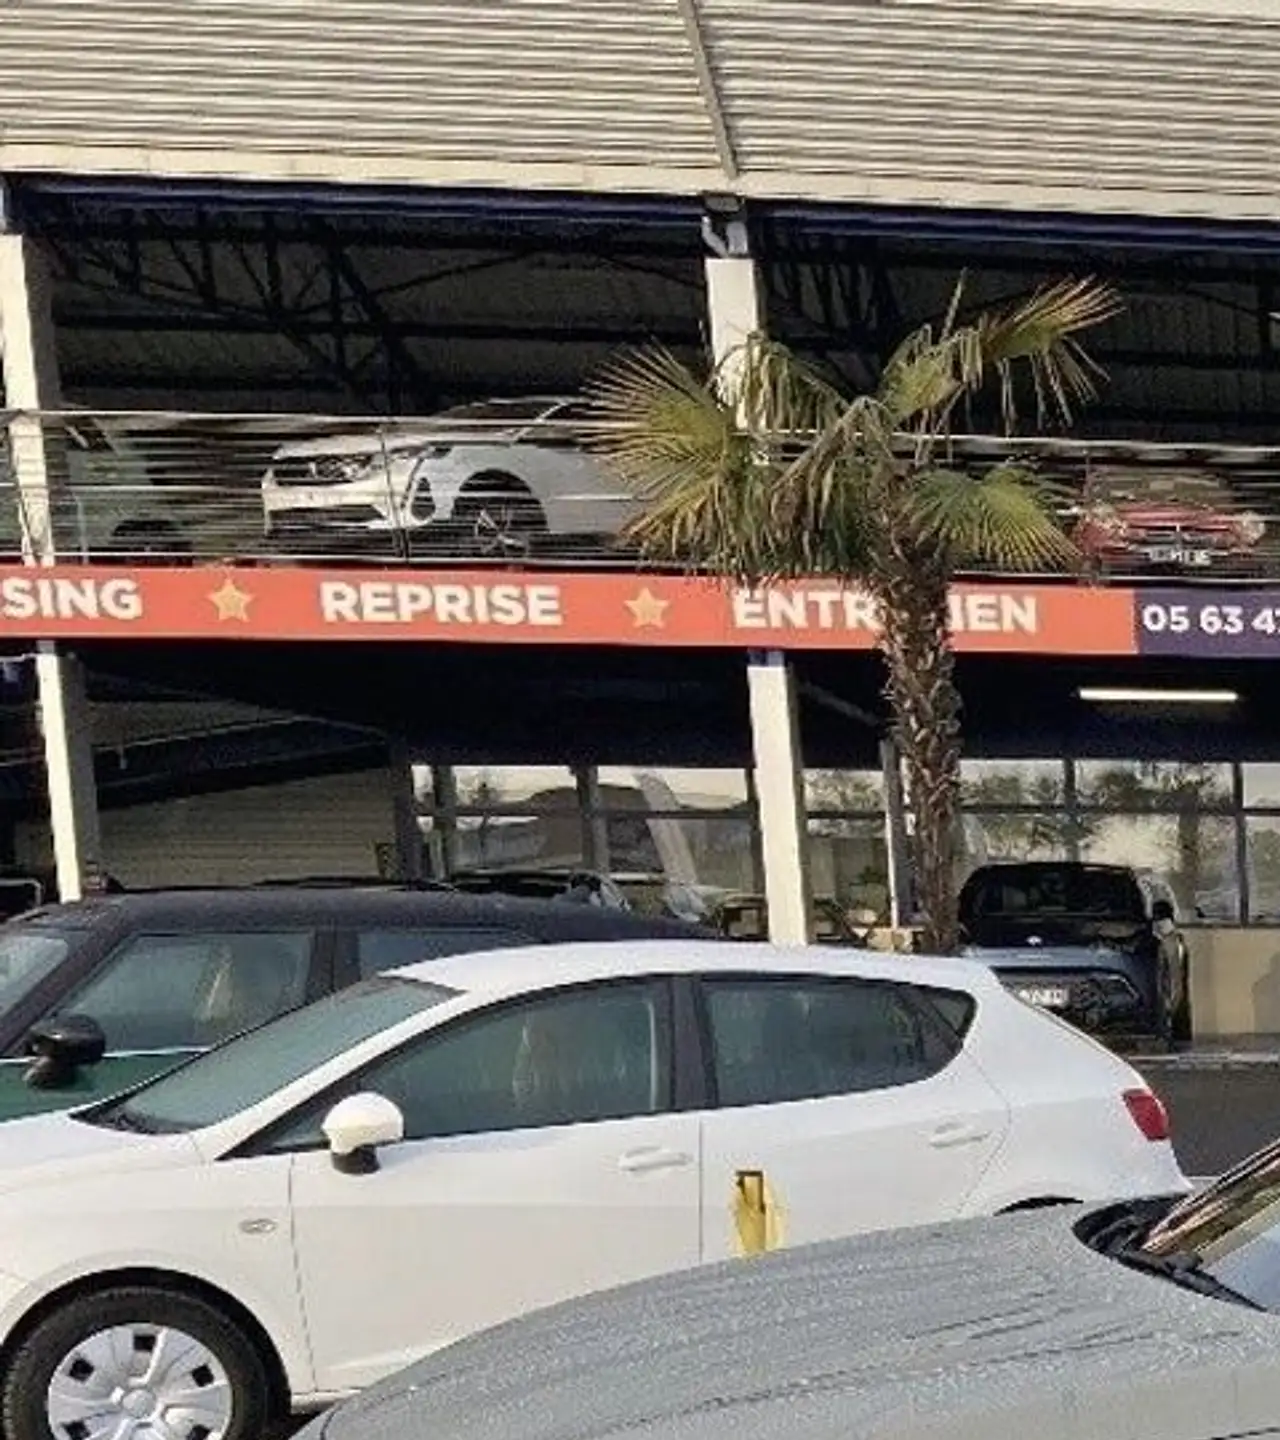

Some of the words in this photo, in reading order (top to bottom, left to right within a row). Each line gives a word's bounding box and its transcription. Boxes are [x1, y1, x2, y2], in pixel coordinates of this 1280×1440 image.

[320, 582, 563, 628] REPRISE
[732, 587, 1038, 635] ENTRIEN
[1142, 604, 1190, 633] 05
[1199, 605, 1245, 635] 63
